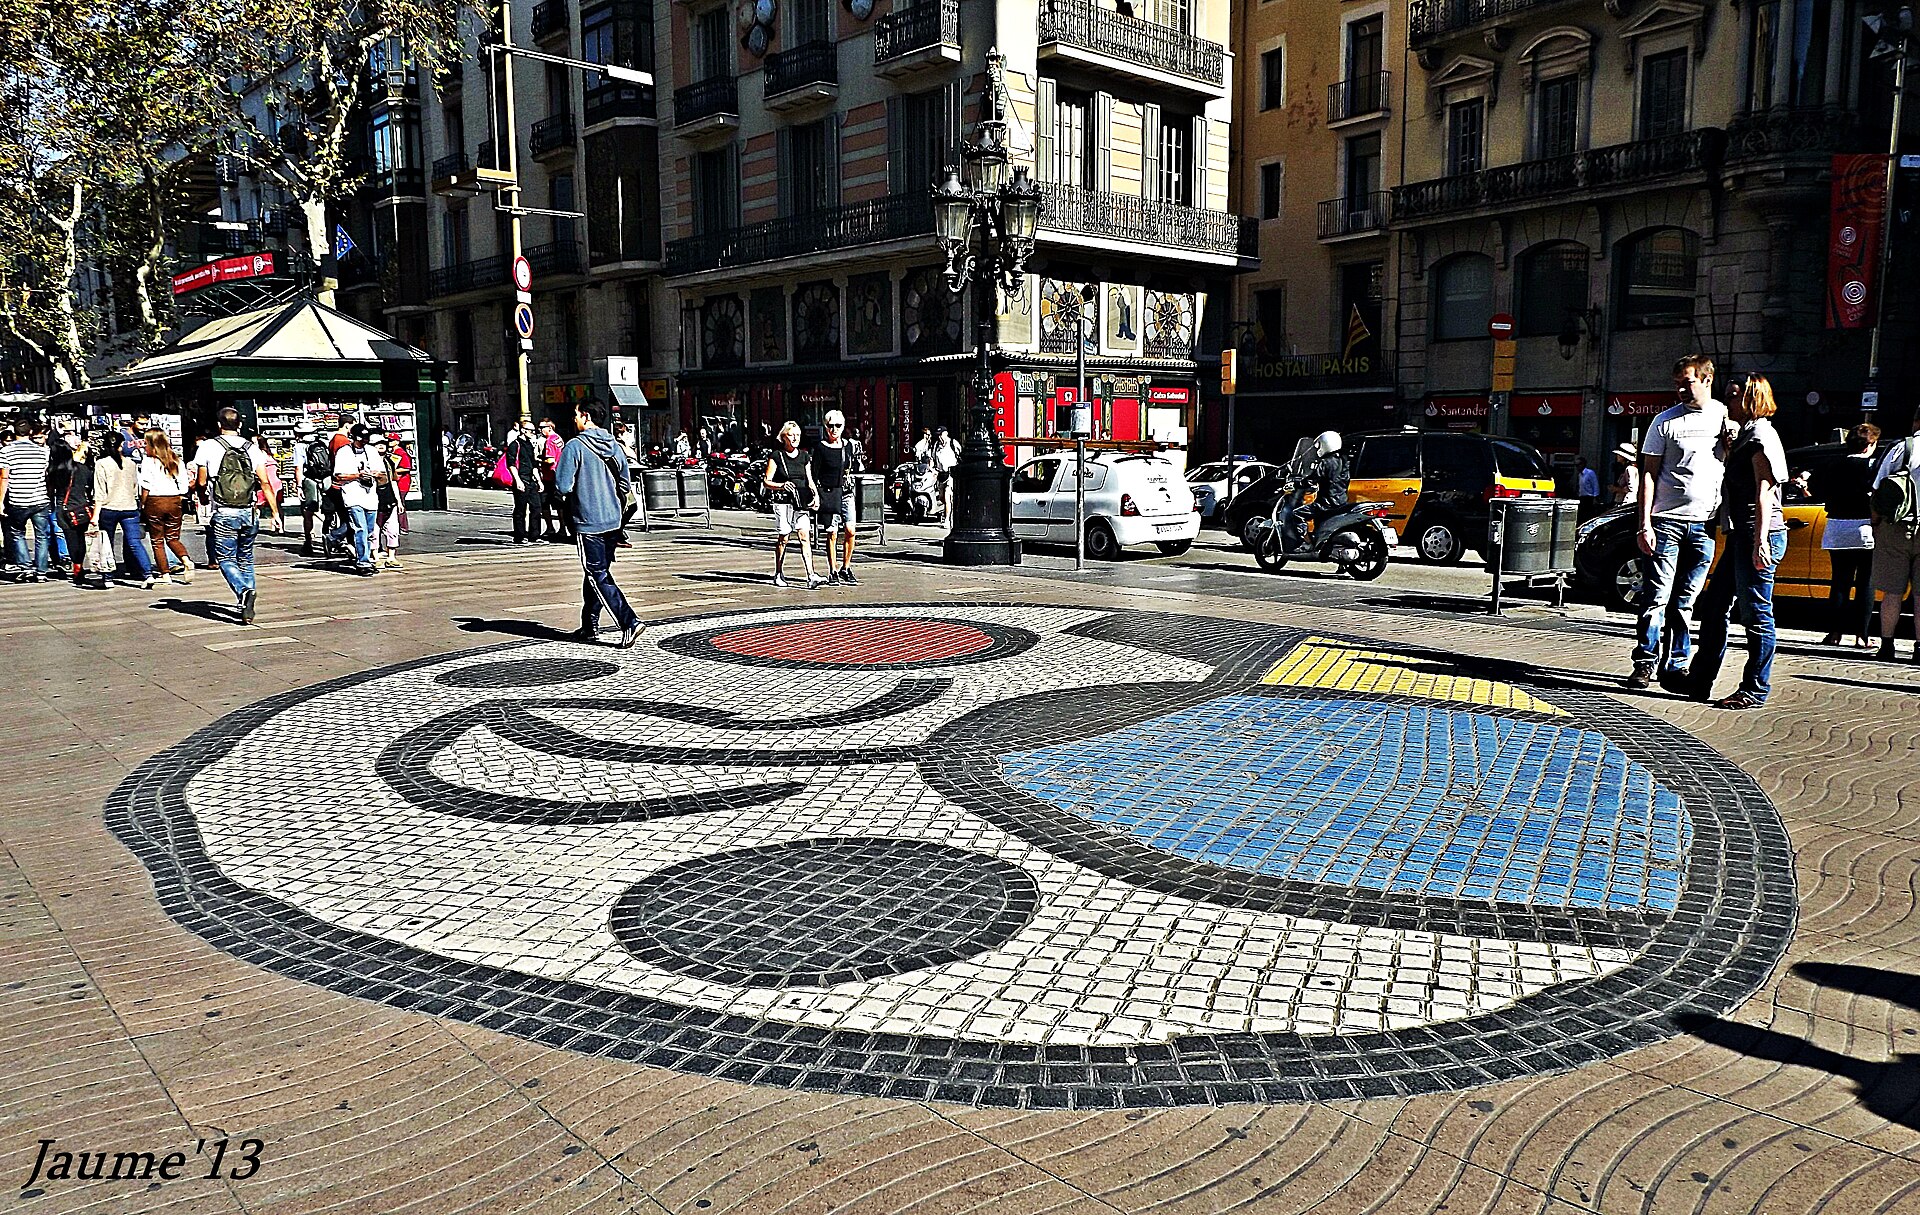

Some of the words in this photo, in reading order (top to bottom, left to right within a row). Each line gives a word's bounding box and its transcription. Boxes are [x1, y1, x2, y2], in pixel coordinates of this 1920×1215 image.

[1255, 361, 1310, 378] HOSTAL
[1322, 356, 1370, 375] PARIS
[1440, 403, 1488, 416] Santander
[1628, 401, 1676, 415] Santan
